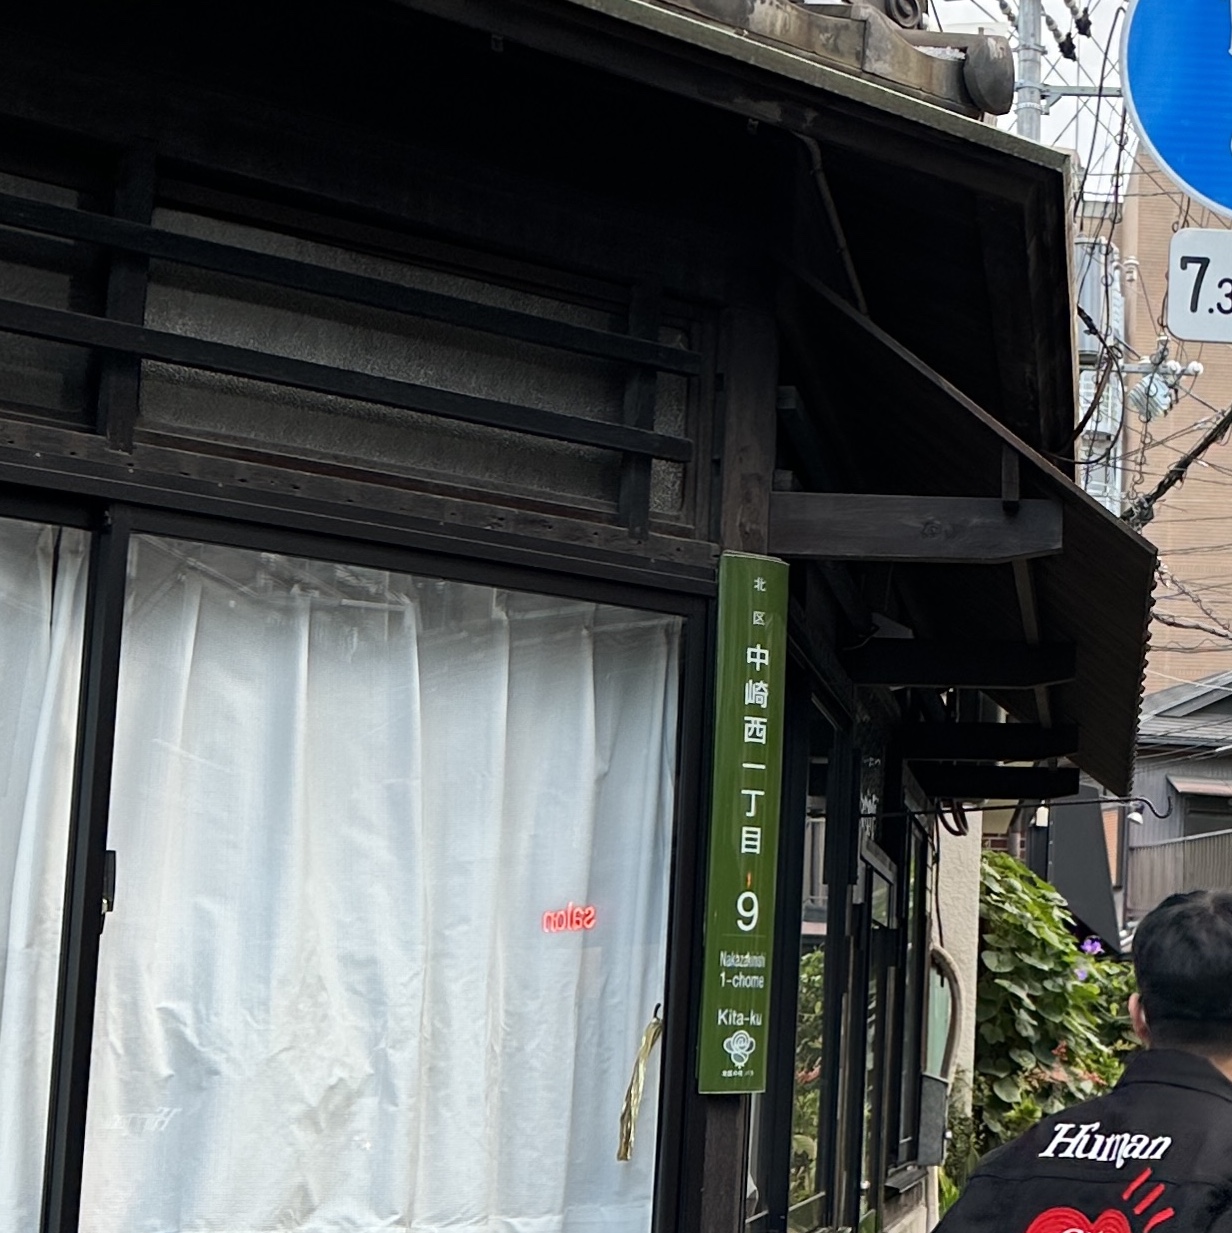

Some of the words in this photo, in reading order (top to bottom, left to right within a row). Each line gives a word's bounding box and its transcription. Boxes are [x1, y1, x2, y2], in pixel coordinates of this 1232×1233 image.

[753, 576, 767, 626] 北区
[741, 643, 769, 854] 中崎西一丁目
[736, 891, 759, 932] 9
[720, 971, 765, 988] 1-chome
[717, 1009, 762, 1026] Kita-ku
[1038, 1122, 1172, 1168] Human
